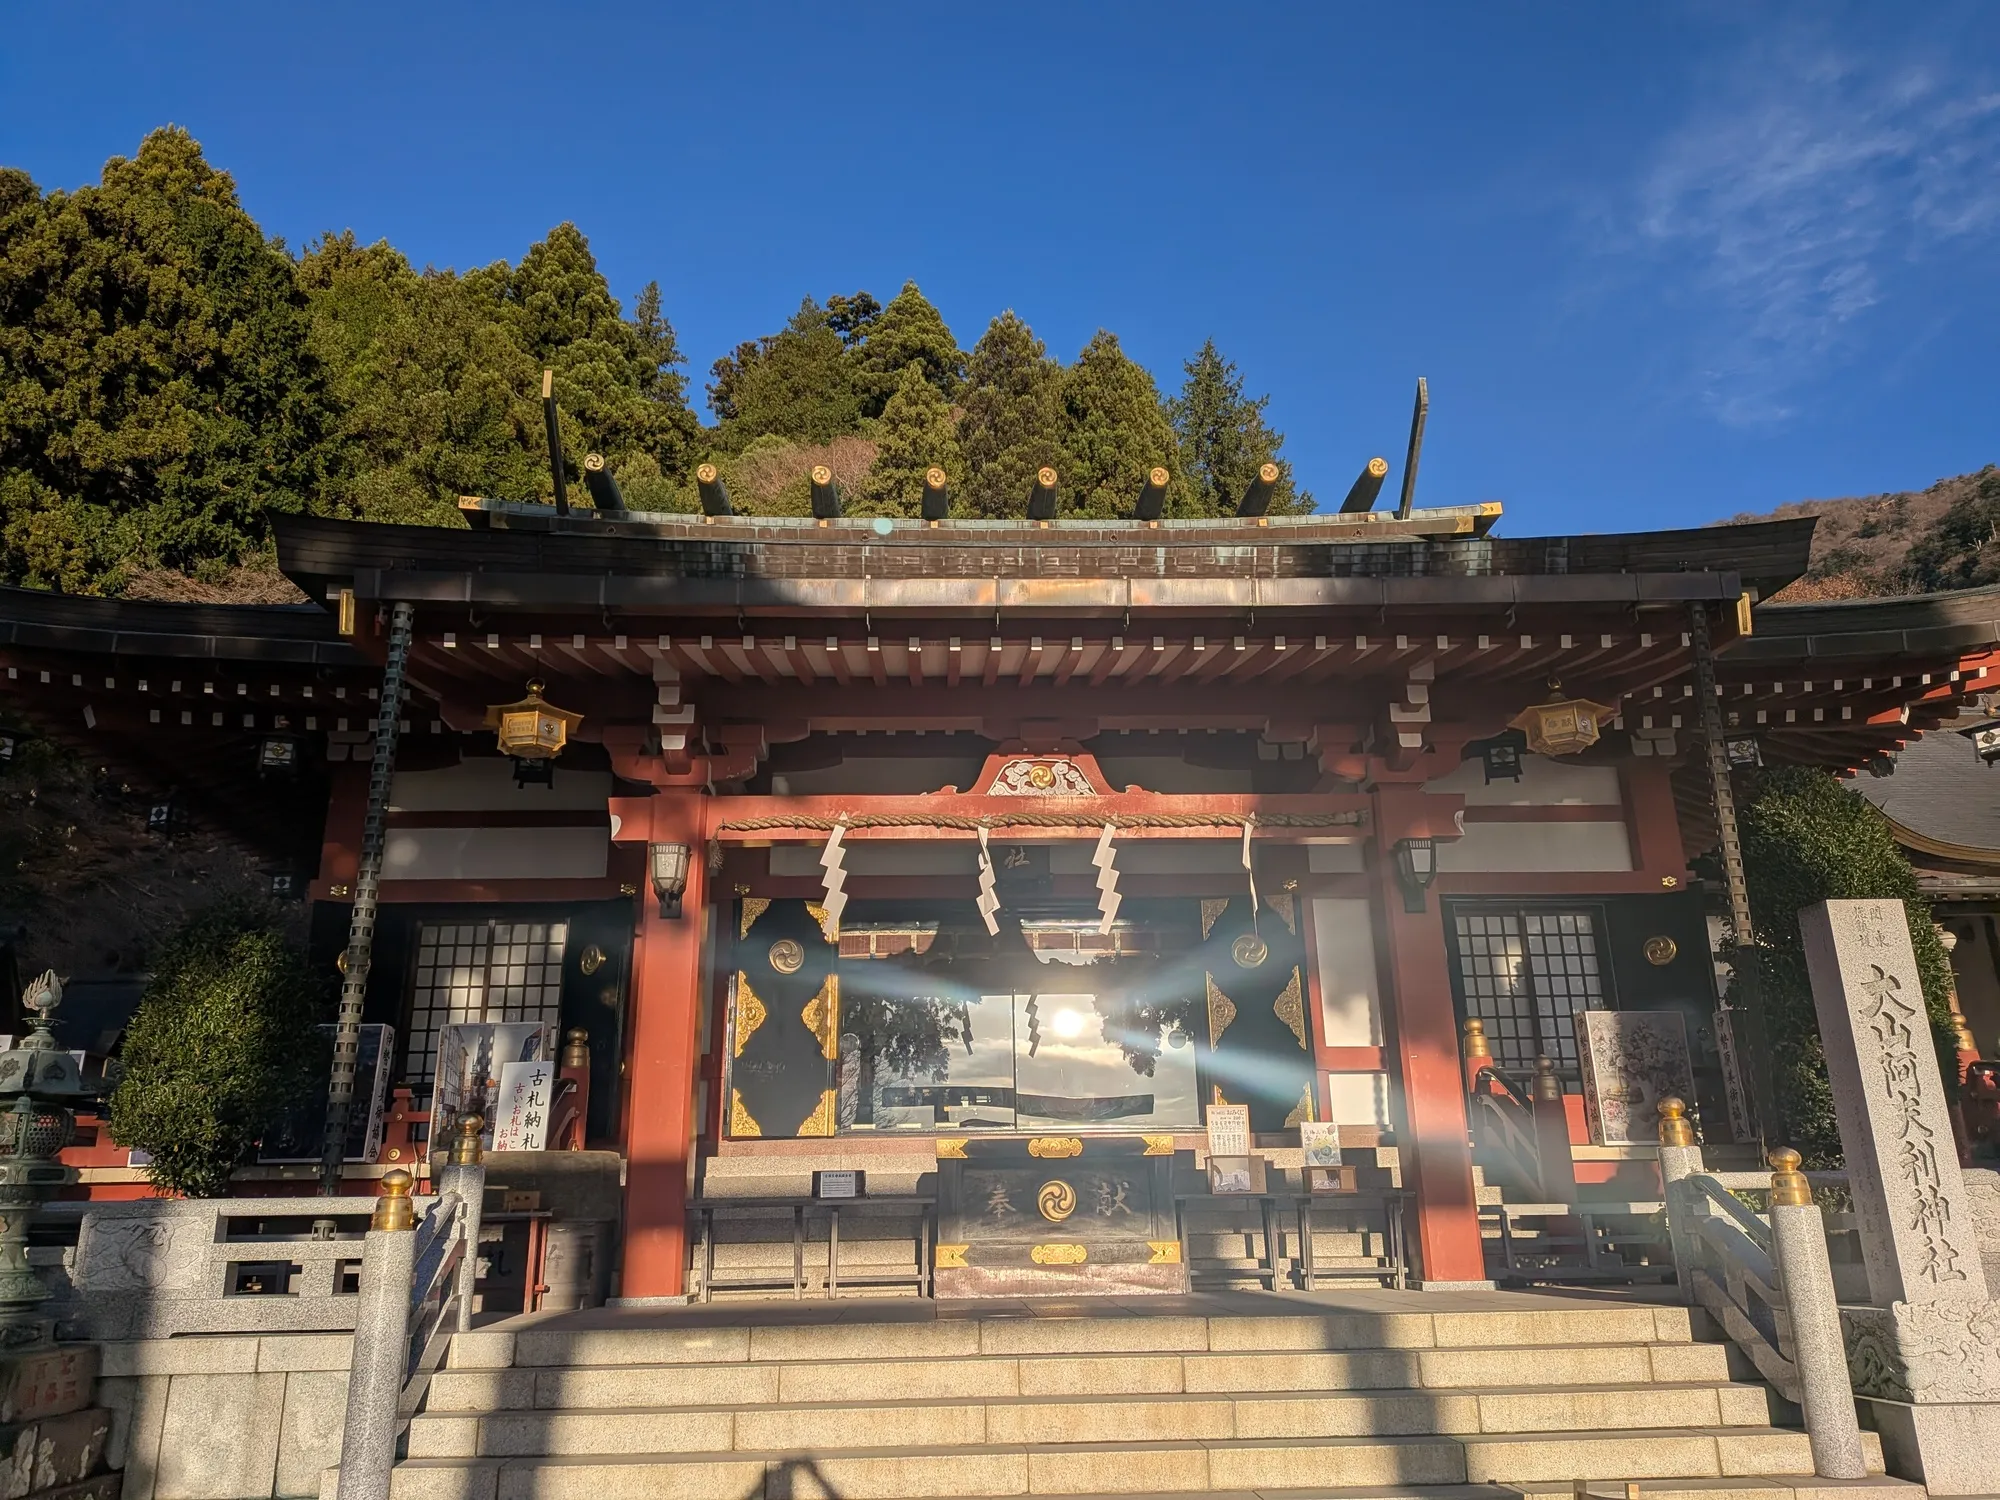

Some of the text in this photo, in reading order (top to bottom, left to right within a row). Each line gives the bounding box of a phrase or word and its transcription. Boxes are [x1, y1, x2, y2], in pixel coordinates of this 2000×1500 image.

[520, 1069, 547, 1150] 古札納札
[1858, 963, 1967, 1284] 大山阿夫利神社
[984, 1184, 1017, 1218] 奉
